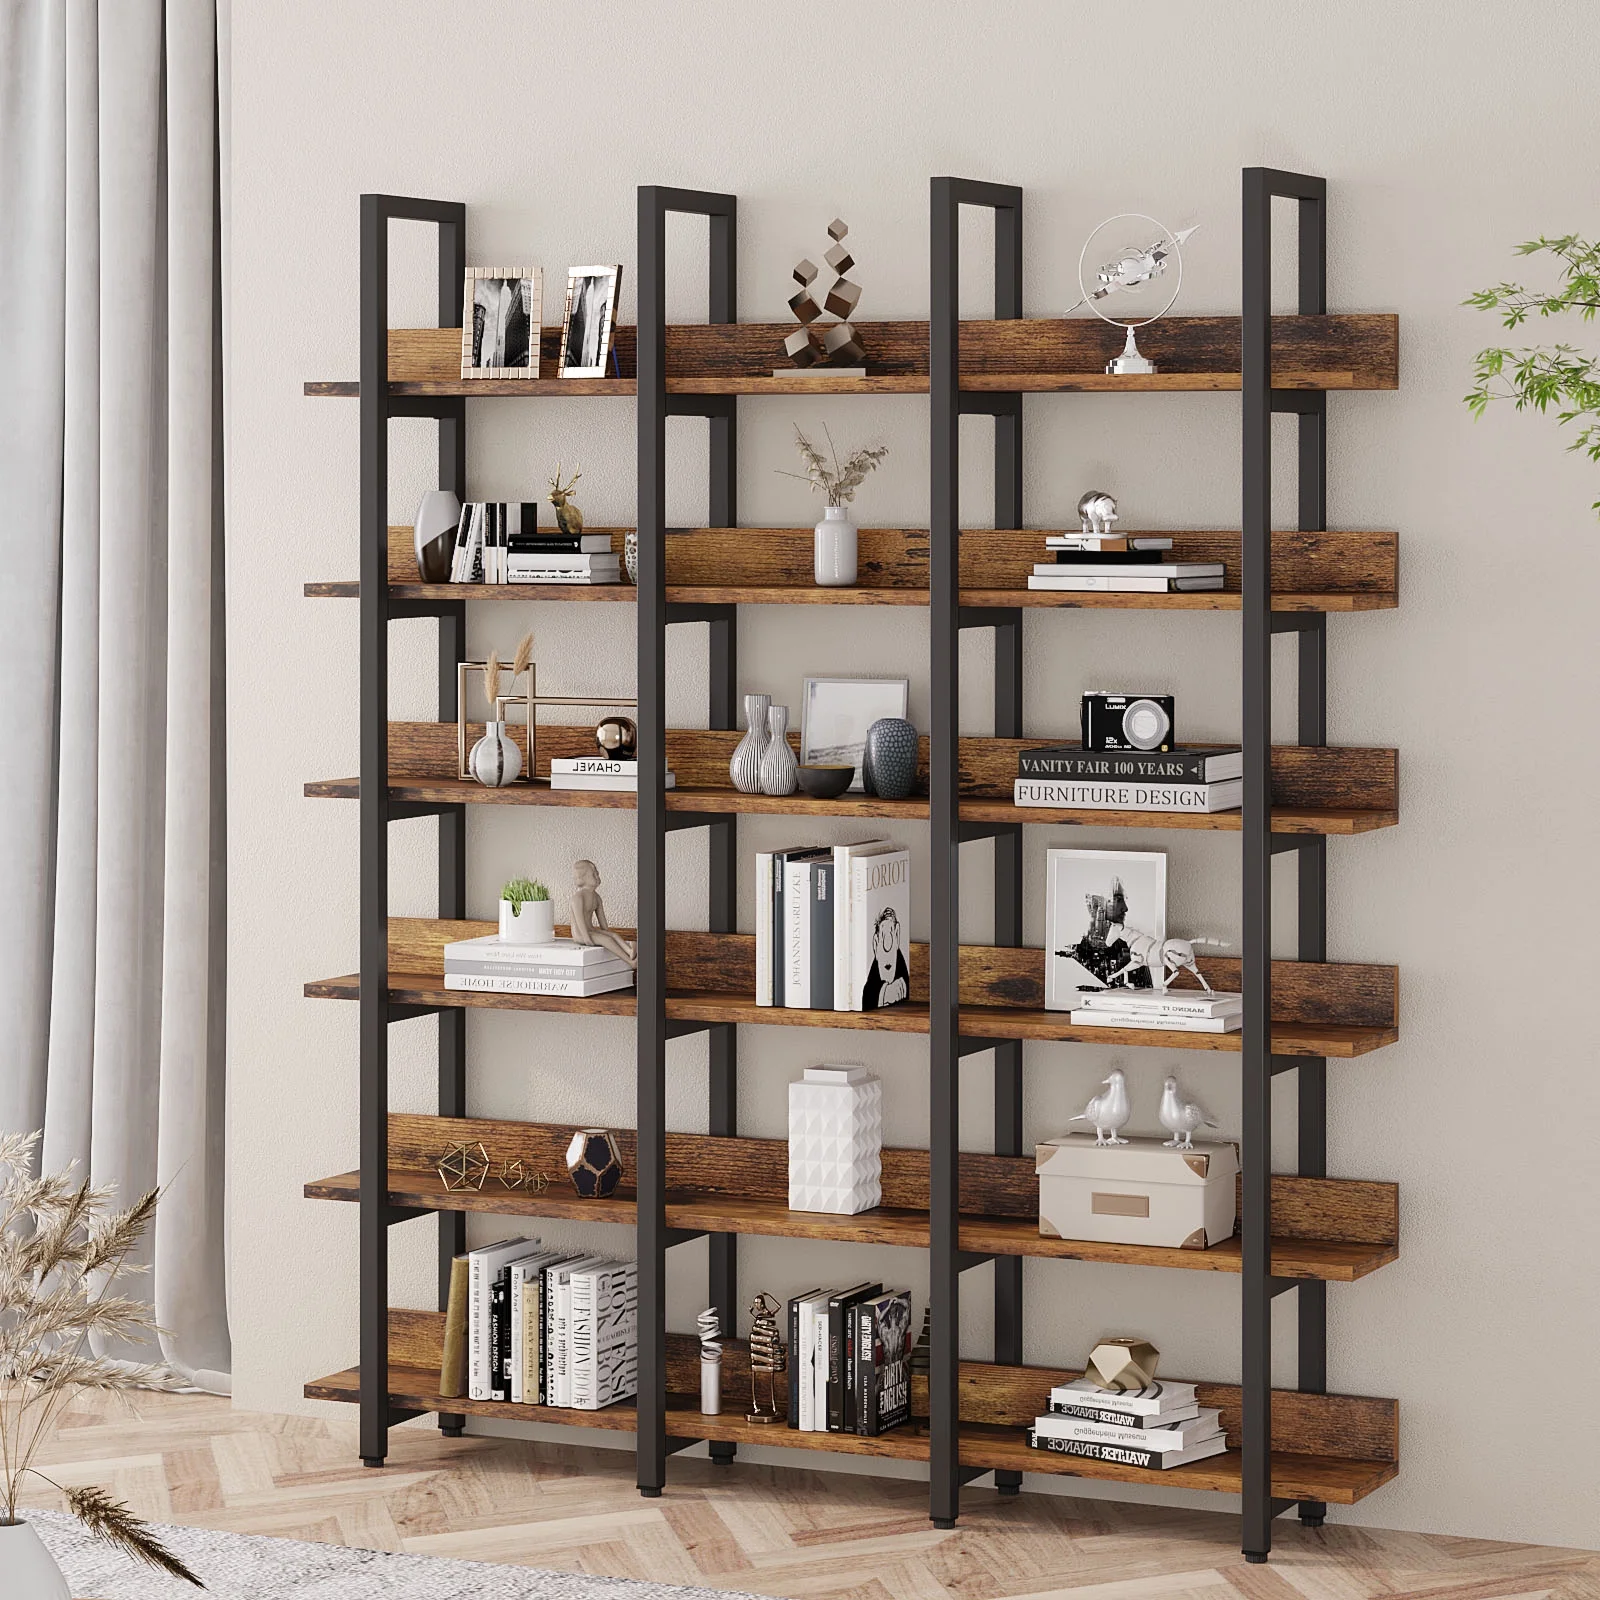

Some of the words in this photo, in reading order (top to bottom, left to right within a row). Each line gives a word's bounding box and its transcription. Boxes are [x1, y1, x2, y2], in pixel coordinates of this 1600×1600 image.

[1022, 759, 1073, 774] VANITY
[1078, 760, 1110, 774] FAIR
[1114, 762, 1134, 775] 100
[1138, 762, 1184, 776] YEARS
[1018, 786, 1129, 804] FURNITURE
[1135, 790, 1207, 806] DESIGN
[866, 859, 908, 892] LORIOT
[792, 927, 801, 987] JOHANNES
[574, 1277, 591, 1304] THE
[574, 1308, 591, 1364] FASHION
[884, 1361, 903, 1391] DIRTY
[880, 1382, 908, 1414] ENGLISH
